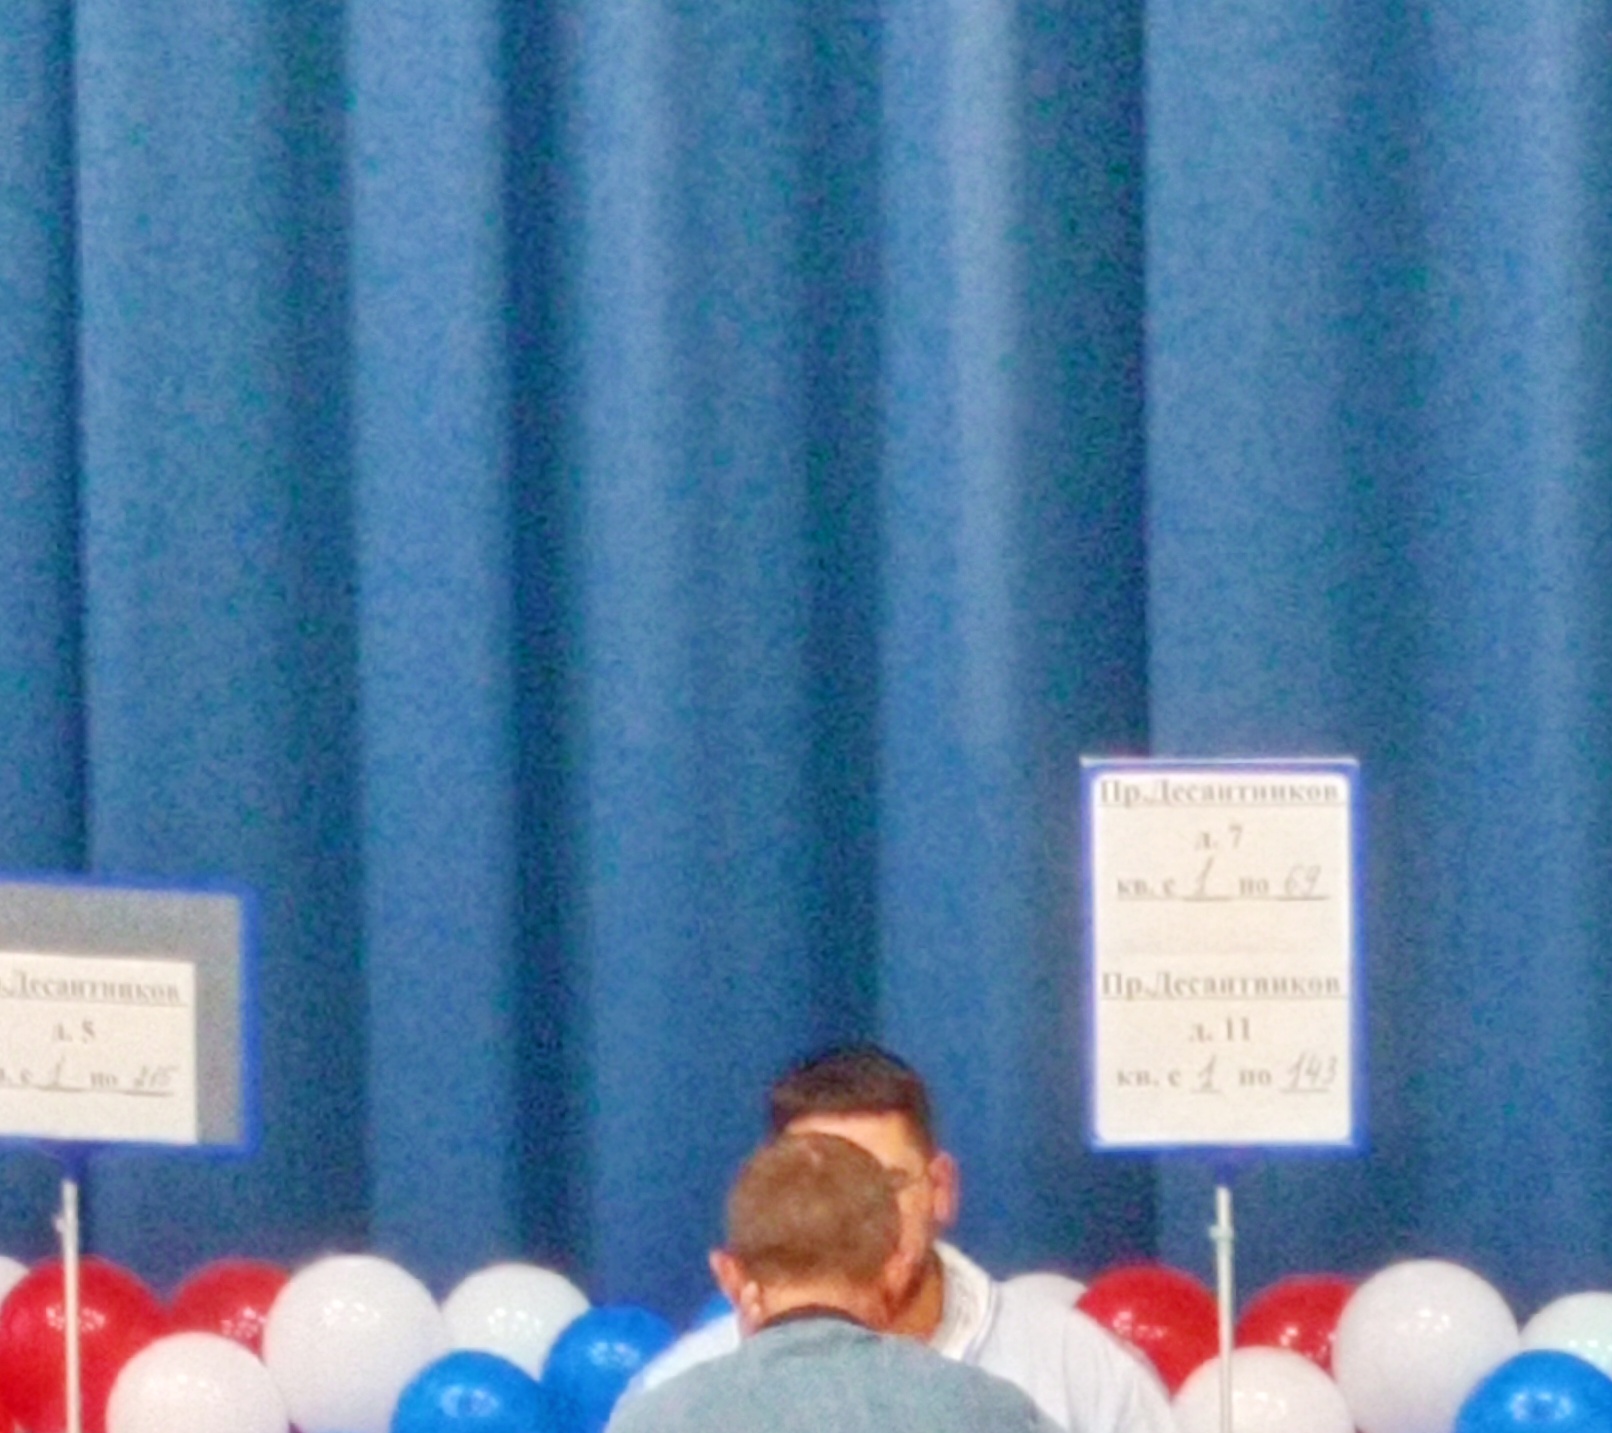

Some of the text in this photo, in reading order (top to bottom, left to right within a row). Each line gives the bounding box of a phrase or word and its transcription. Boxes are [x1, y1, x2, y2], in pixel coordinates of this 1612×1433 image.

[1100, 779, 1338, 808] Пр.Десантников
[1229, 826, 1243, 849] 7
[1117, 857, 1322, 897] кв. с 1 по 69
[0, 969, 180, 1003] .Десантников
[1101, 973, 1341, 1001] Пр.Десантников
[1225, 1018, 1251, 1041] 11
[90, 1071, 118, 1088] по
[1117, 1051, 1338, 1091] кв. с 1 по 143
